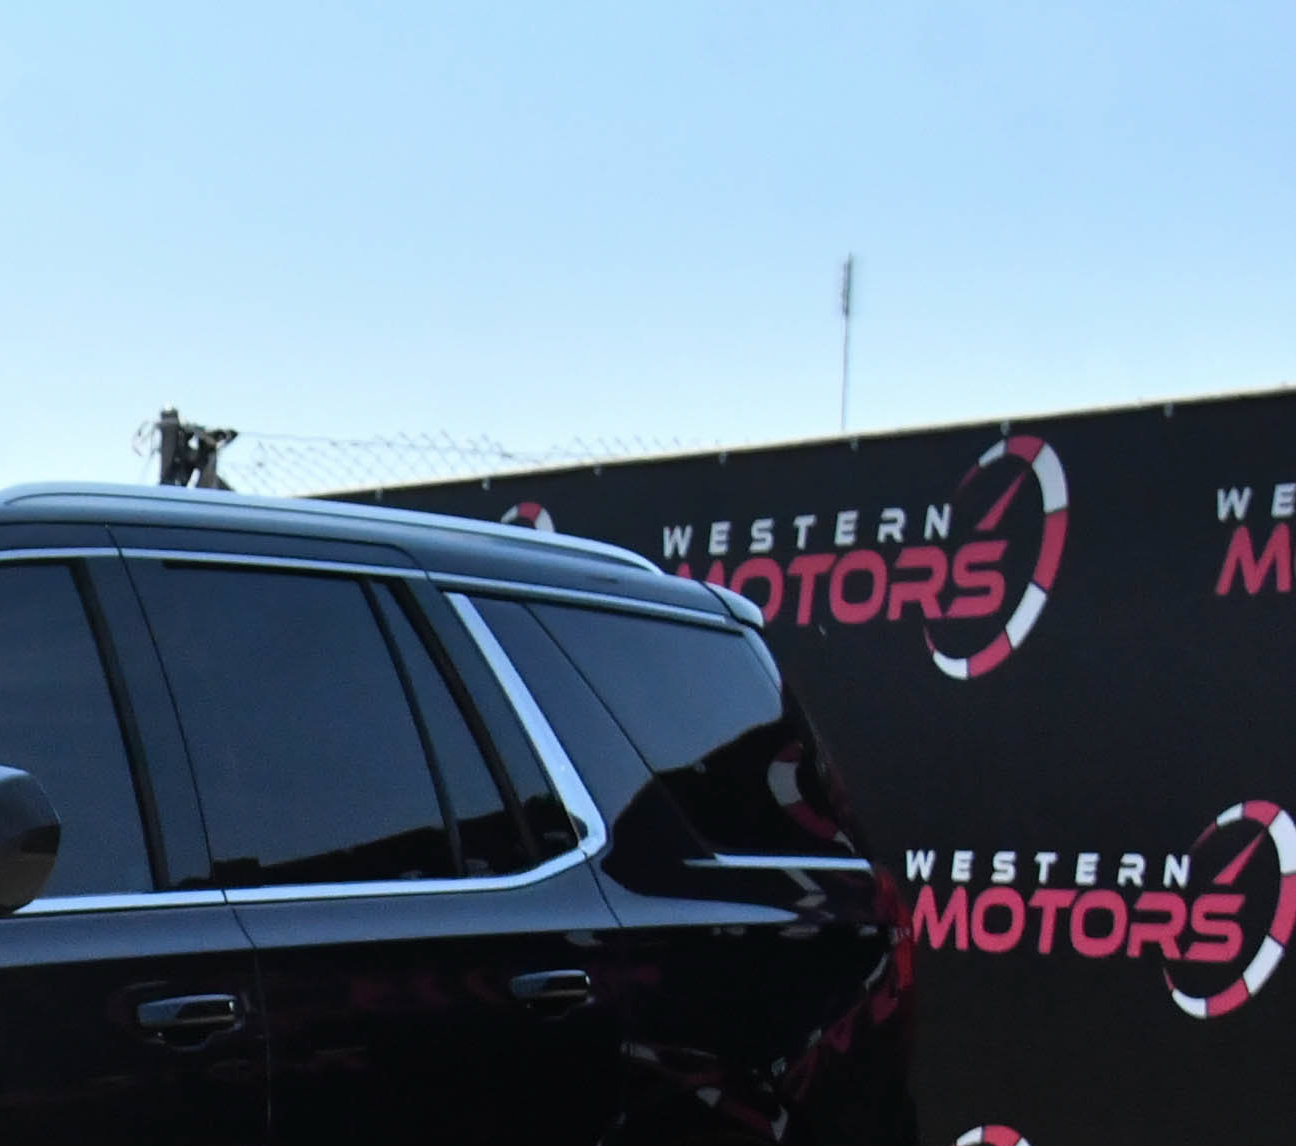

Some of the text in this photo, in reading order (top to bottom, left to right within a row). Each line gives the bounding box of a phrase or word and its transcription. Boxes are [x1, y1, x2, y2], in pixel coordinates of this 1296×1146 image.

[662, 503, 952, 559] WESTERN
[675, 539, 1009, 625] OTORS
[905, 849, 1191, 887] WESTERN
[909, 885, 1246, 962] MOTORS
